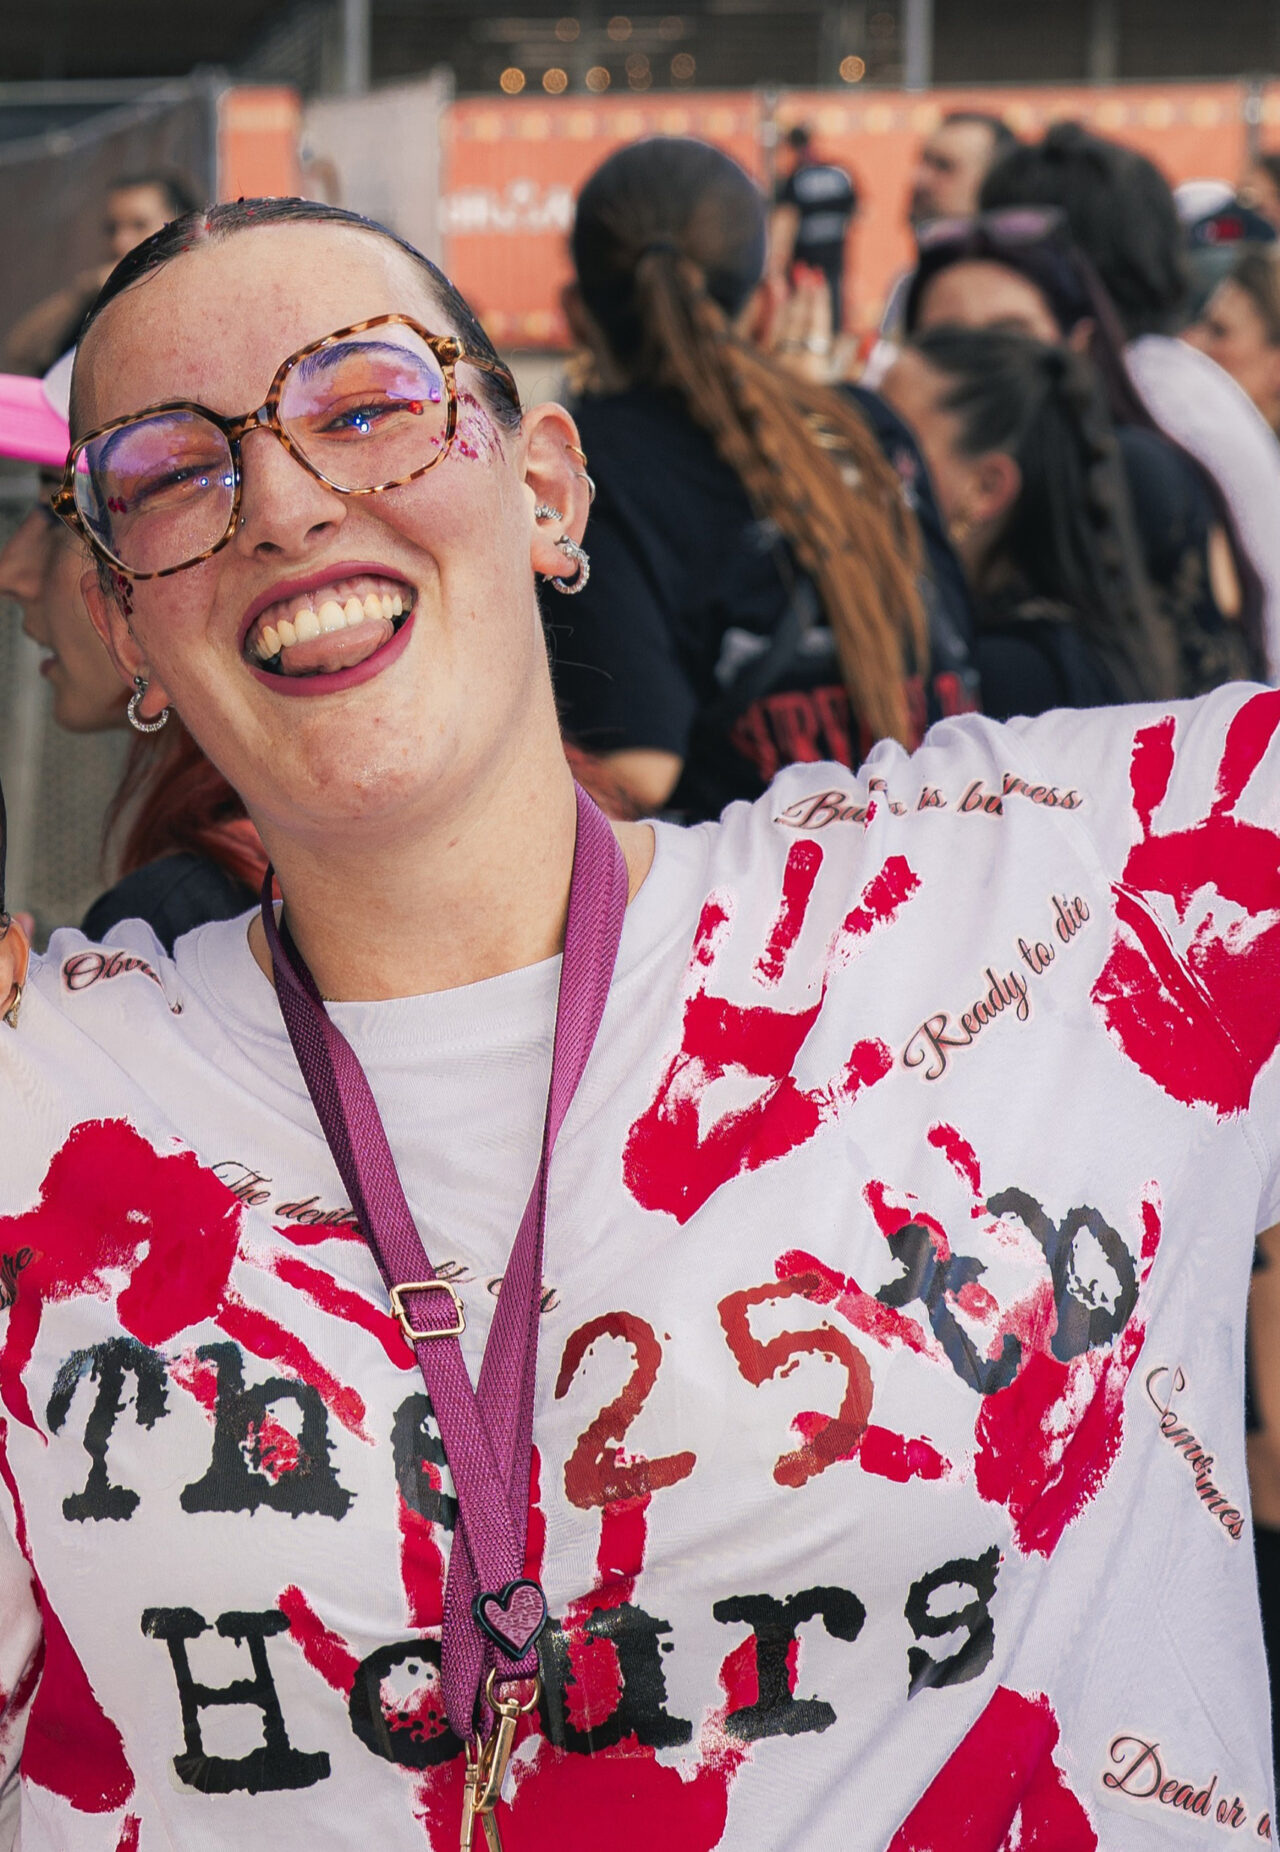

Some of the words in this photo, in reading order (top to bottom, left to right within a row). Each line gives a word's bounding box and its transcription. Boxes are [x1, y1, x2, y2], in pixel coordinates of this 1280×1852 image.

[903, 968, 1029, 1081] Ready
[1018, 937, 1056, 975] to
[1051, 893, 1091, 944] die
[211, 1160, 273, 1207] The
[140, 1546, 1003, 1796] Hours
[1102, 1736, 1218, 1817] Dead
[1215, 1796, 1248, 1829] or
